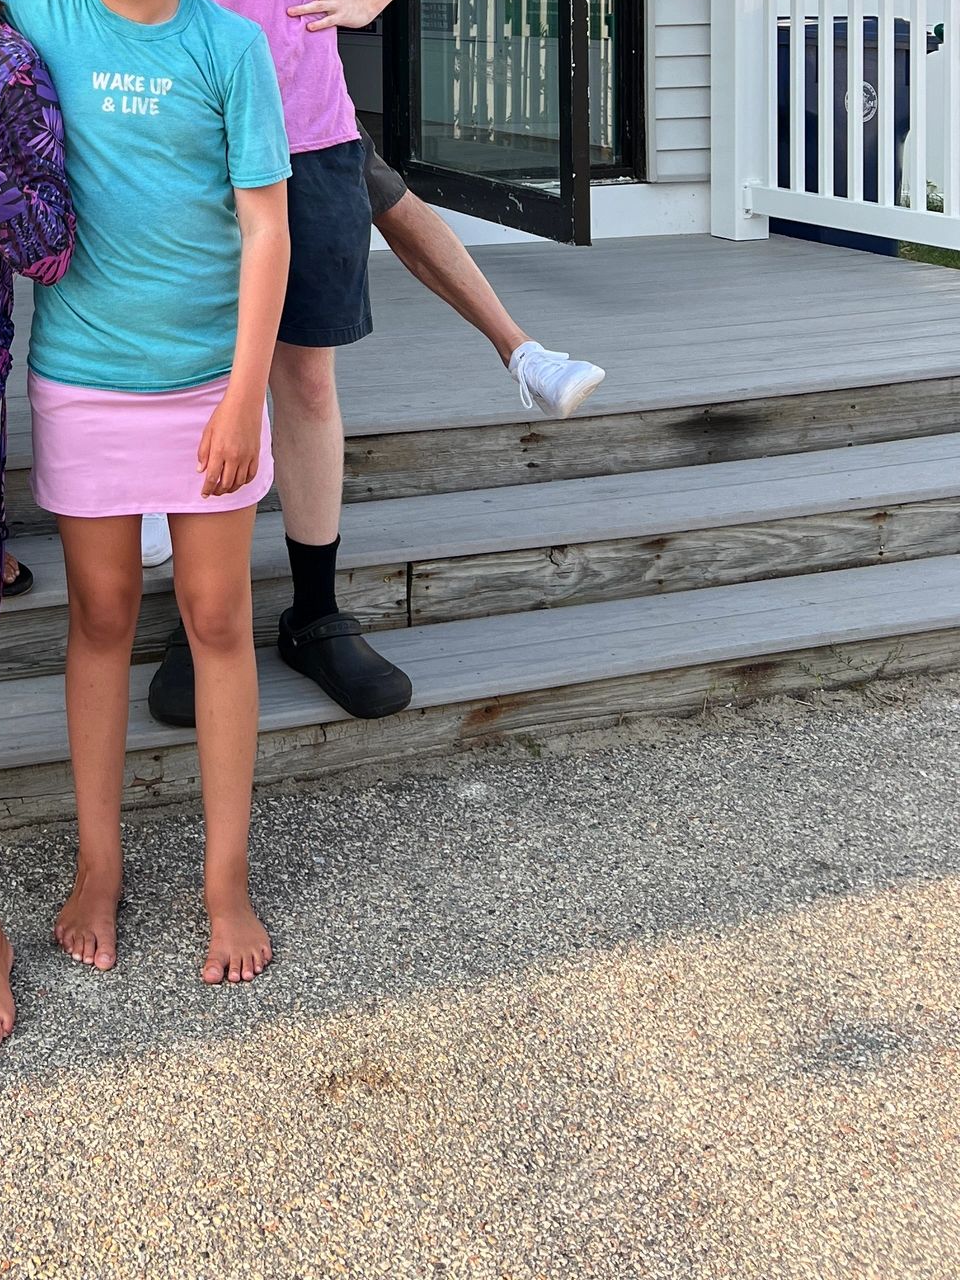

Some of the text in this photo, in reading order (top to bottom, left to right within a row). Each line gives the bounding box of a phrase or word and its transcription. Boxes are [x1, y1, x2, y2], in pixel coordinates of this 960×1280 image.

[92, 71, 173, 96] WAKE UP
[101, 96, 160, 116] & LIVE
